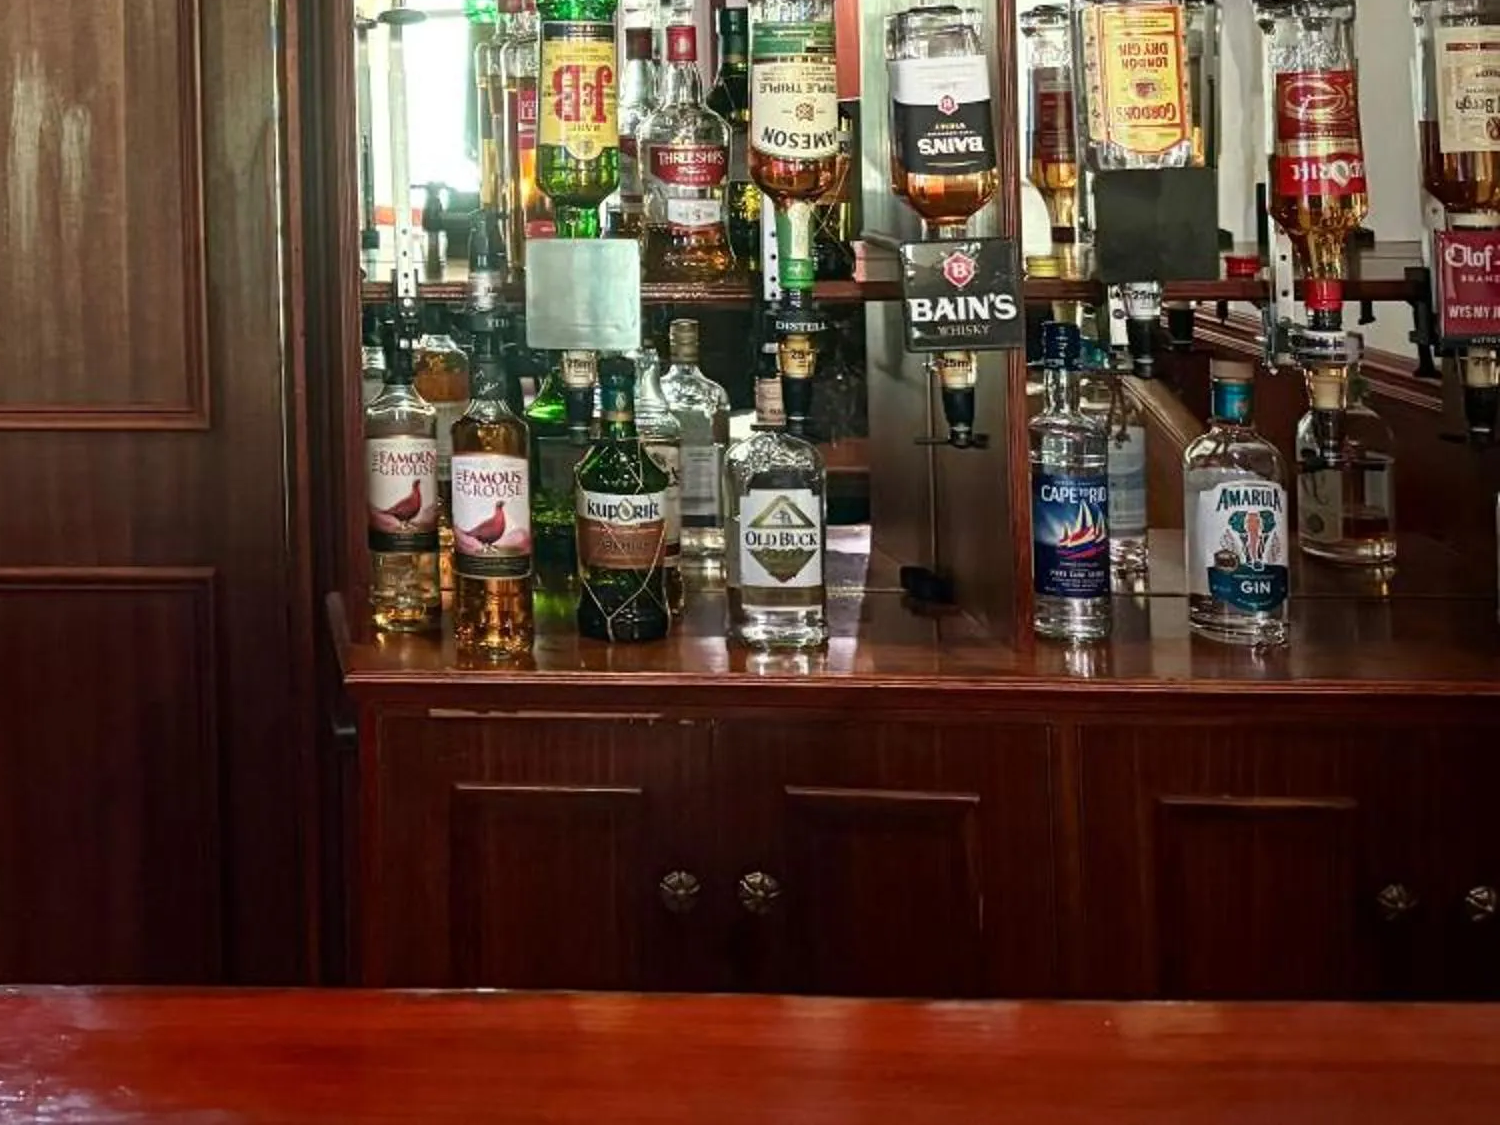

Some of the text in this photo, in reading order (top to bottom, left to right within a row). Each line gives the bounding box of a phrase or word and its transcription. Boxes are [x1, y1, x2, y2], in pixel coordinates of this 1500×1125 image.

[1143, 42, 1169, 56] DRY
[1121, 56, 1169, 72] LONDON
[916, 135, 985, 156] BAIN'S
[1445, 242, 1494, 272] Olof
[910, 295, 1017, 322] BAIN'S
[937, 324, 990, 336] WHISKY
[380, 449, 438, 465] FAMOUS
[380, 463, 438, 477] GROUSE
[463, 469, 524, 485] FAMOUS
[463, 483, 524, 498] GROUSE
[1041, 484, 1079, 504] CAPE
[1215, 487, 1282, 513] AMARULA
[745, 529, 818, 547] OLD BUCK
[1240, 579, 1272, 594] GIN
